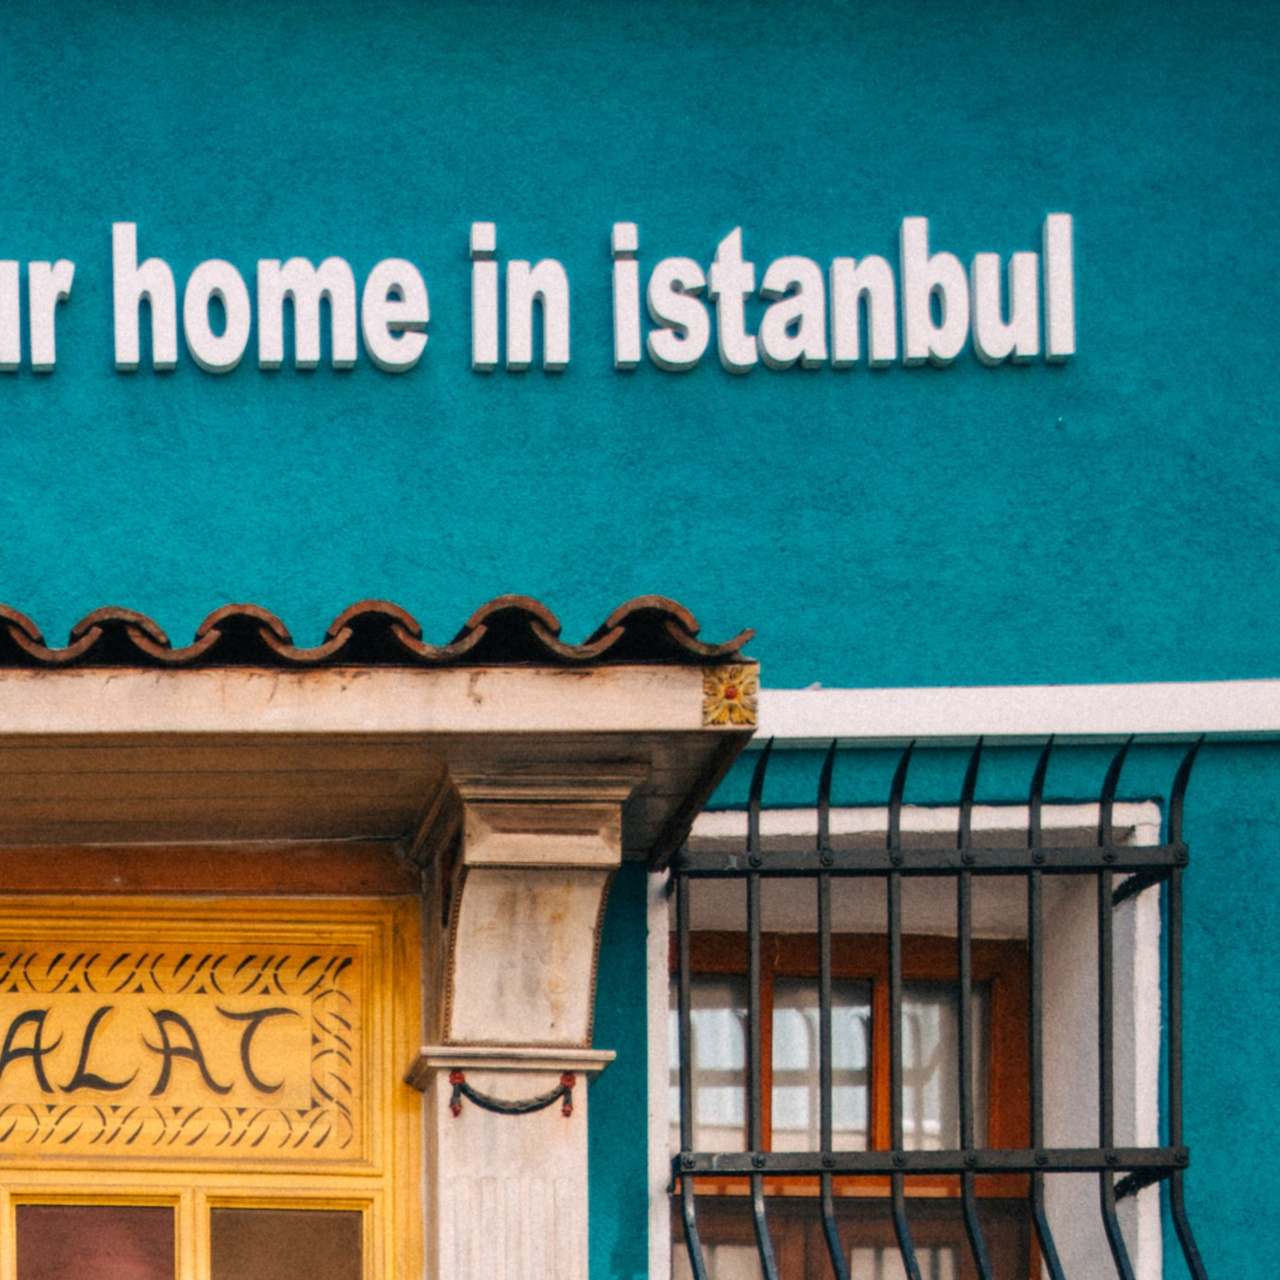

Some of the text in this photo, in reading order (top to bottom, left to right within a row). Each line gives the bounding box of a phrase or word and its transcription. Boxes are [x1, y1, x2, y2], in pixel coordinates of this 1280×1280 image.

[111, 221, 431, 373] home
[469, 221, 570, 373] in
[610, 212, 1075, 373] istanbul
